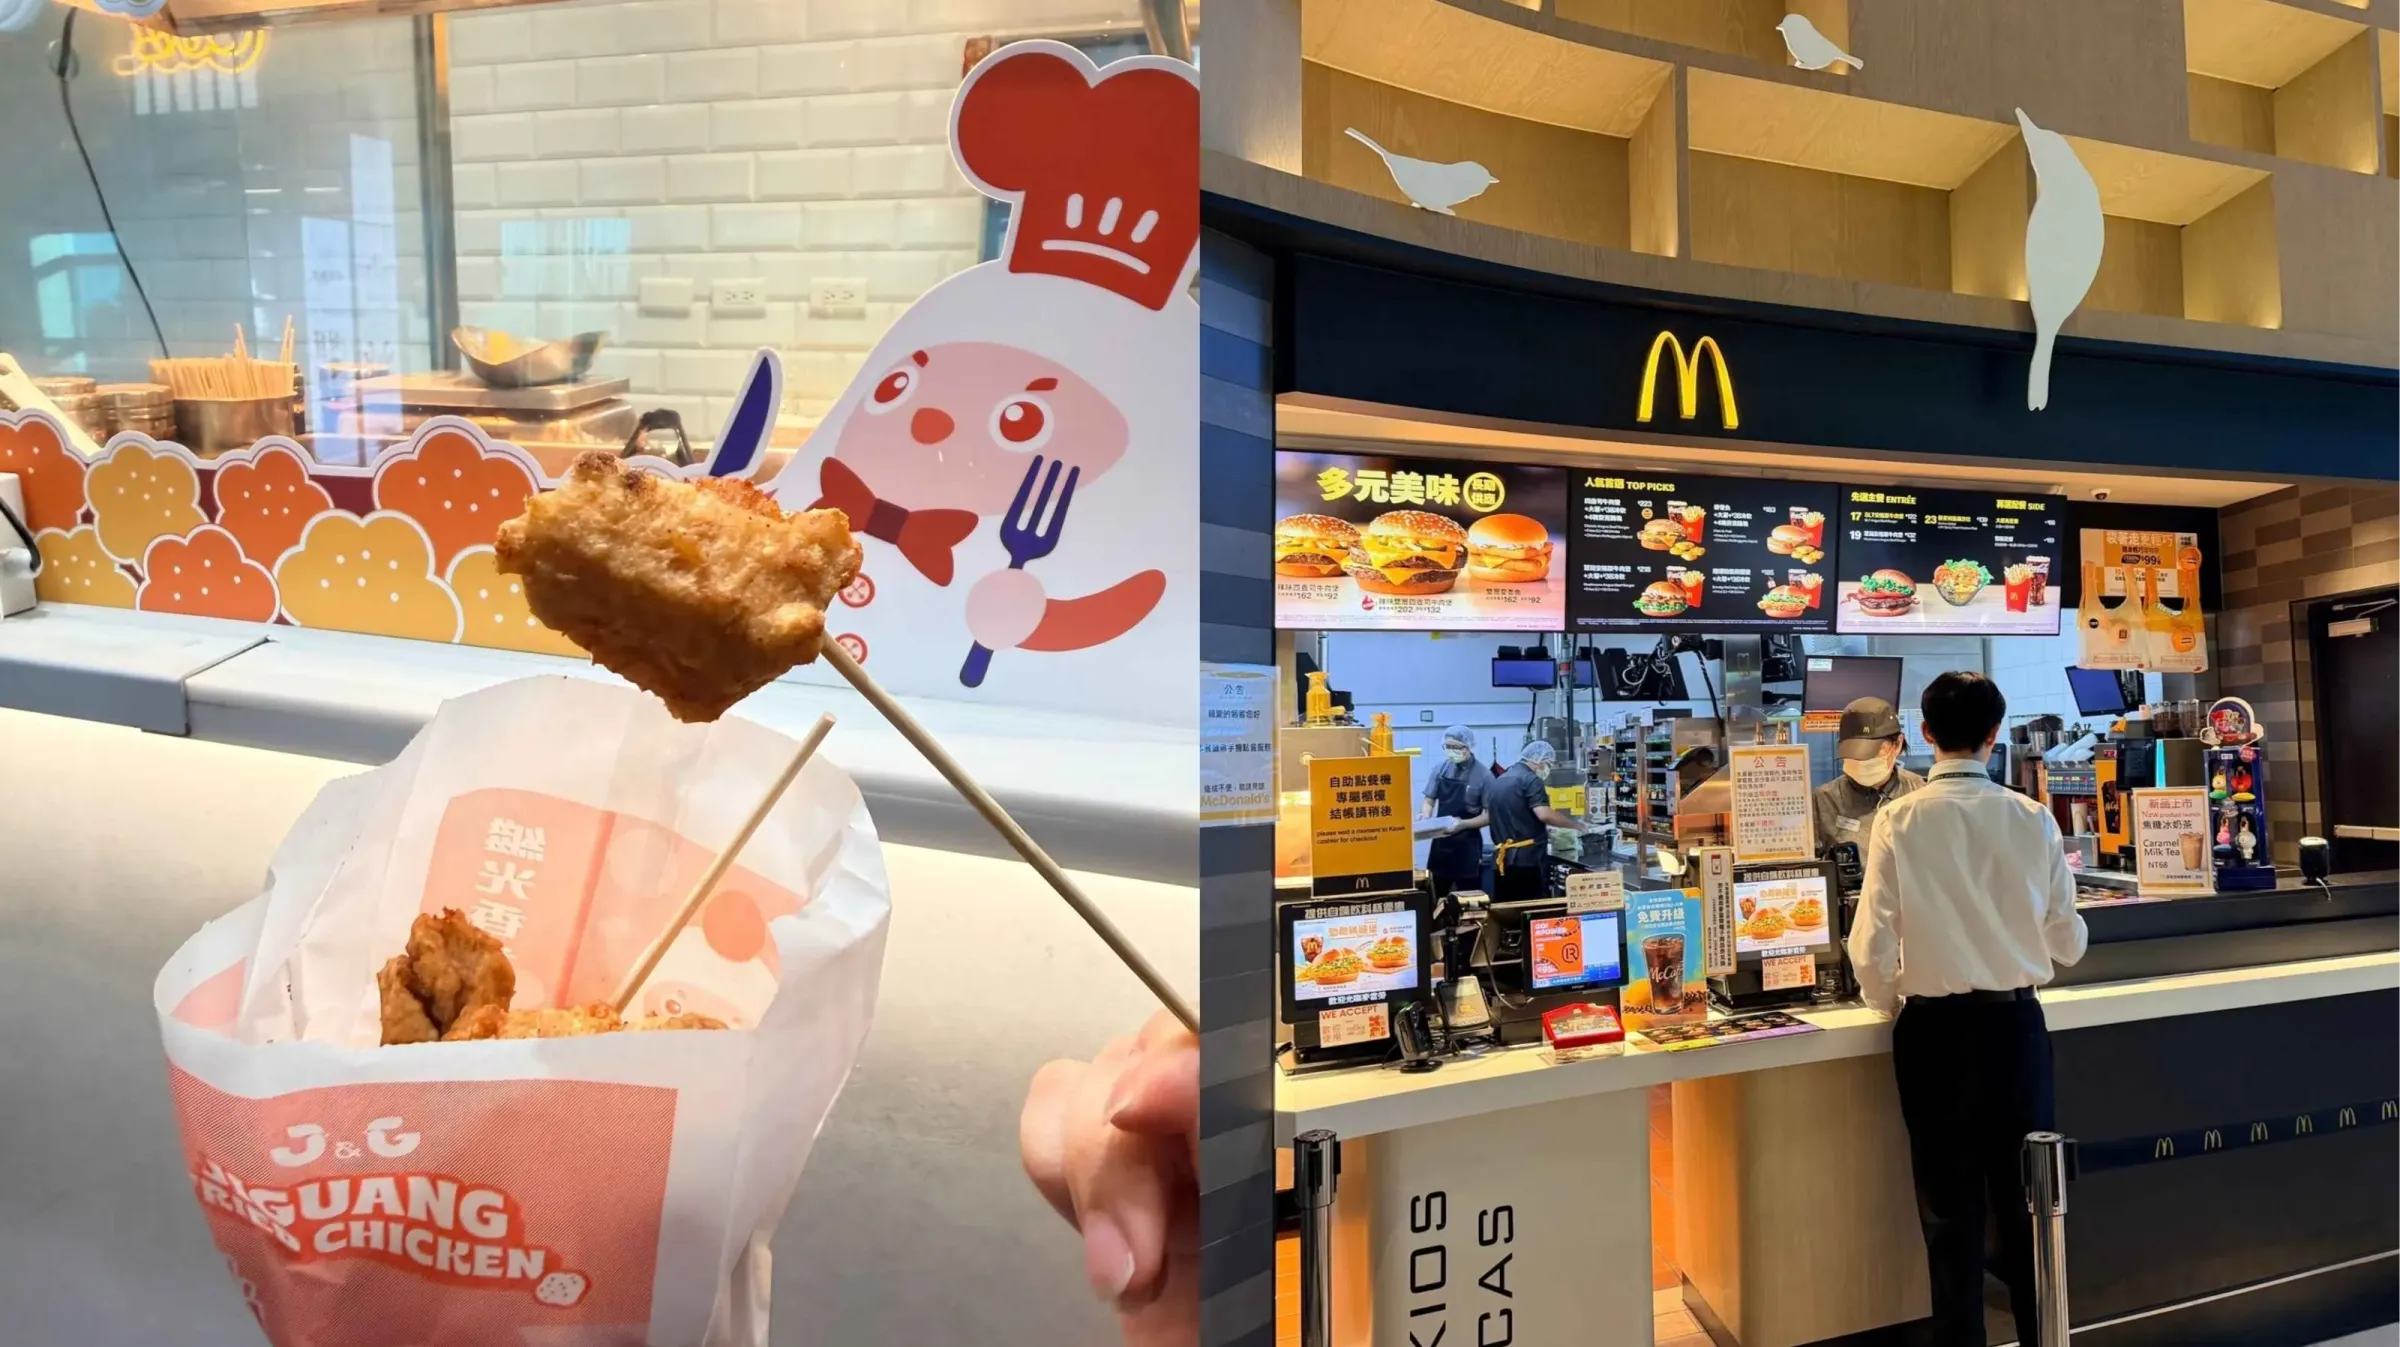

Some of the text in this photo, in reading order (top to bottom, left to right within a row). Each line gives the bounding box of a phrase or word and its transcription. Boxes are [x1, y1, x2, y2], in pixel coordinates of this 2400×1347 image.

[1316, 466, 1461, 506] 多元美味
[1626, 481, 1646, 490] TOP
[1647, 482, 1675, 492] PICKS
[1886, 494, 1917, 505] ENTRÉE
[2028, 502, 2045, 511] SIDE
[1850, 511, 1862, 521] 17
[1924, 514, 1937, 524] 23
[1849, 530, 1862, 540] 19
[1224, 684, 1244, 695] 公告
[1329, 773, 1392, 788] 自助點餐機
[2149, 799, 2193, 809] 新品上市
[1329, 805, 1392, 820] 結帳請稍後
[2143, 820, 2192, 830] 焦糖冰奶茶
[2143, 839, 2180, 847] Caramel
[2144, 848, 2180, 856] Milk Tea
[2148, 861, 2168, 869] NT68
[1637, 907, 1685, 924] 免費升級
[1764, 956, 1807, 967] WE ACCEPT
[1320, 1005, 1377, 1020] WE ACCEPT
[313, 1219, 547, 1281] CHICKEN
